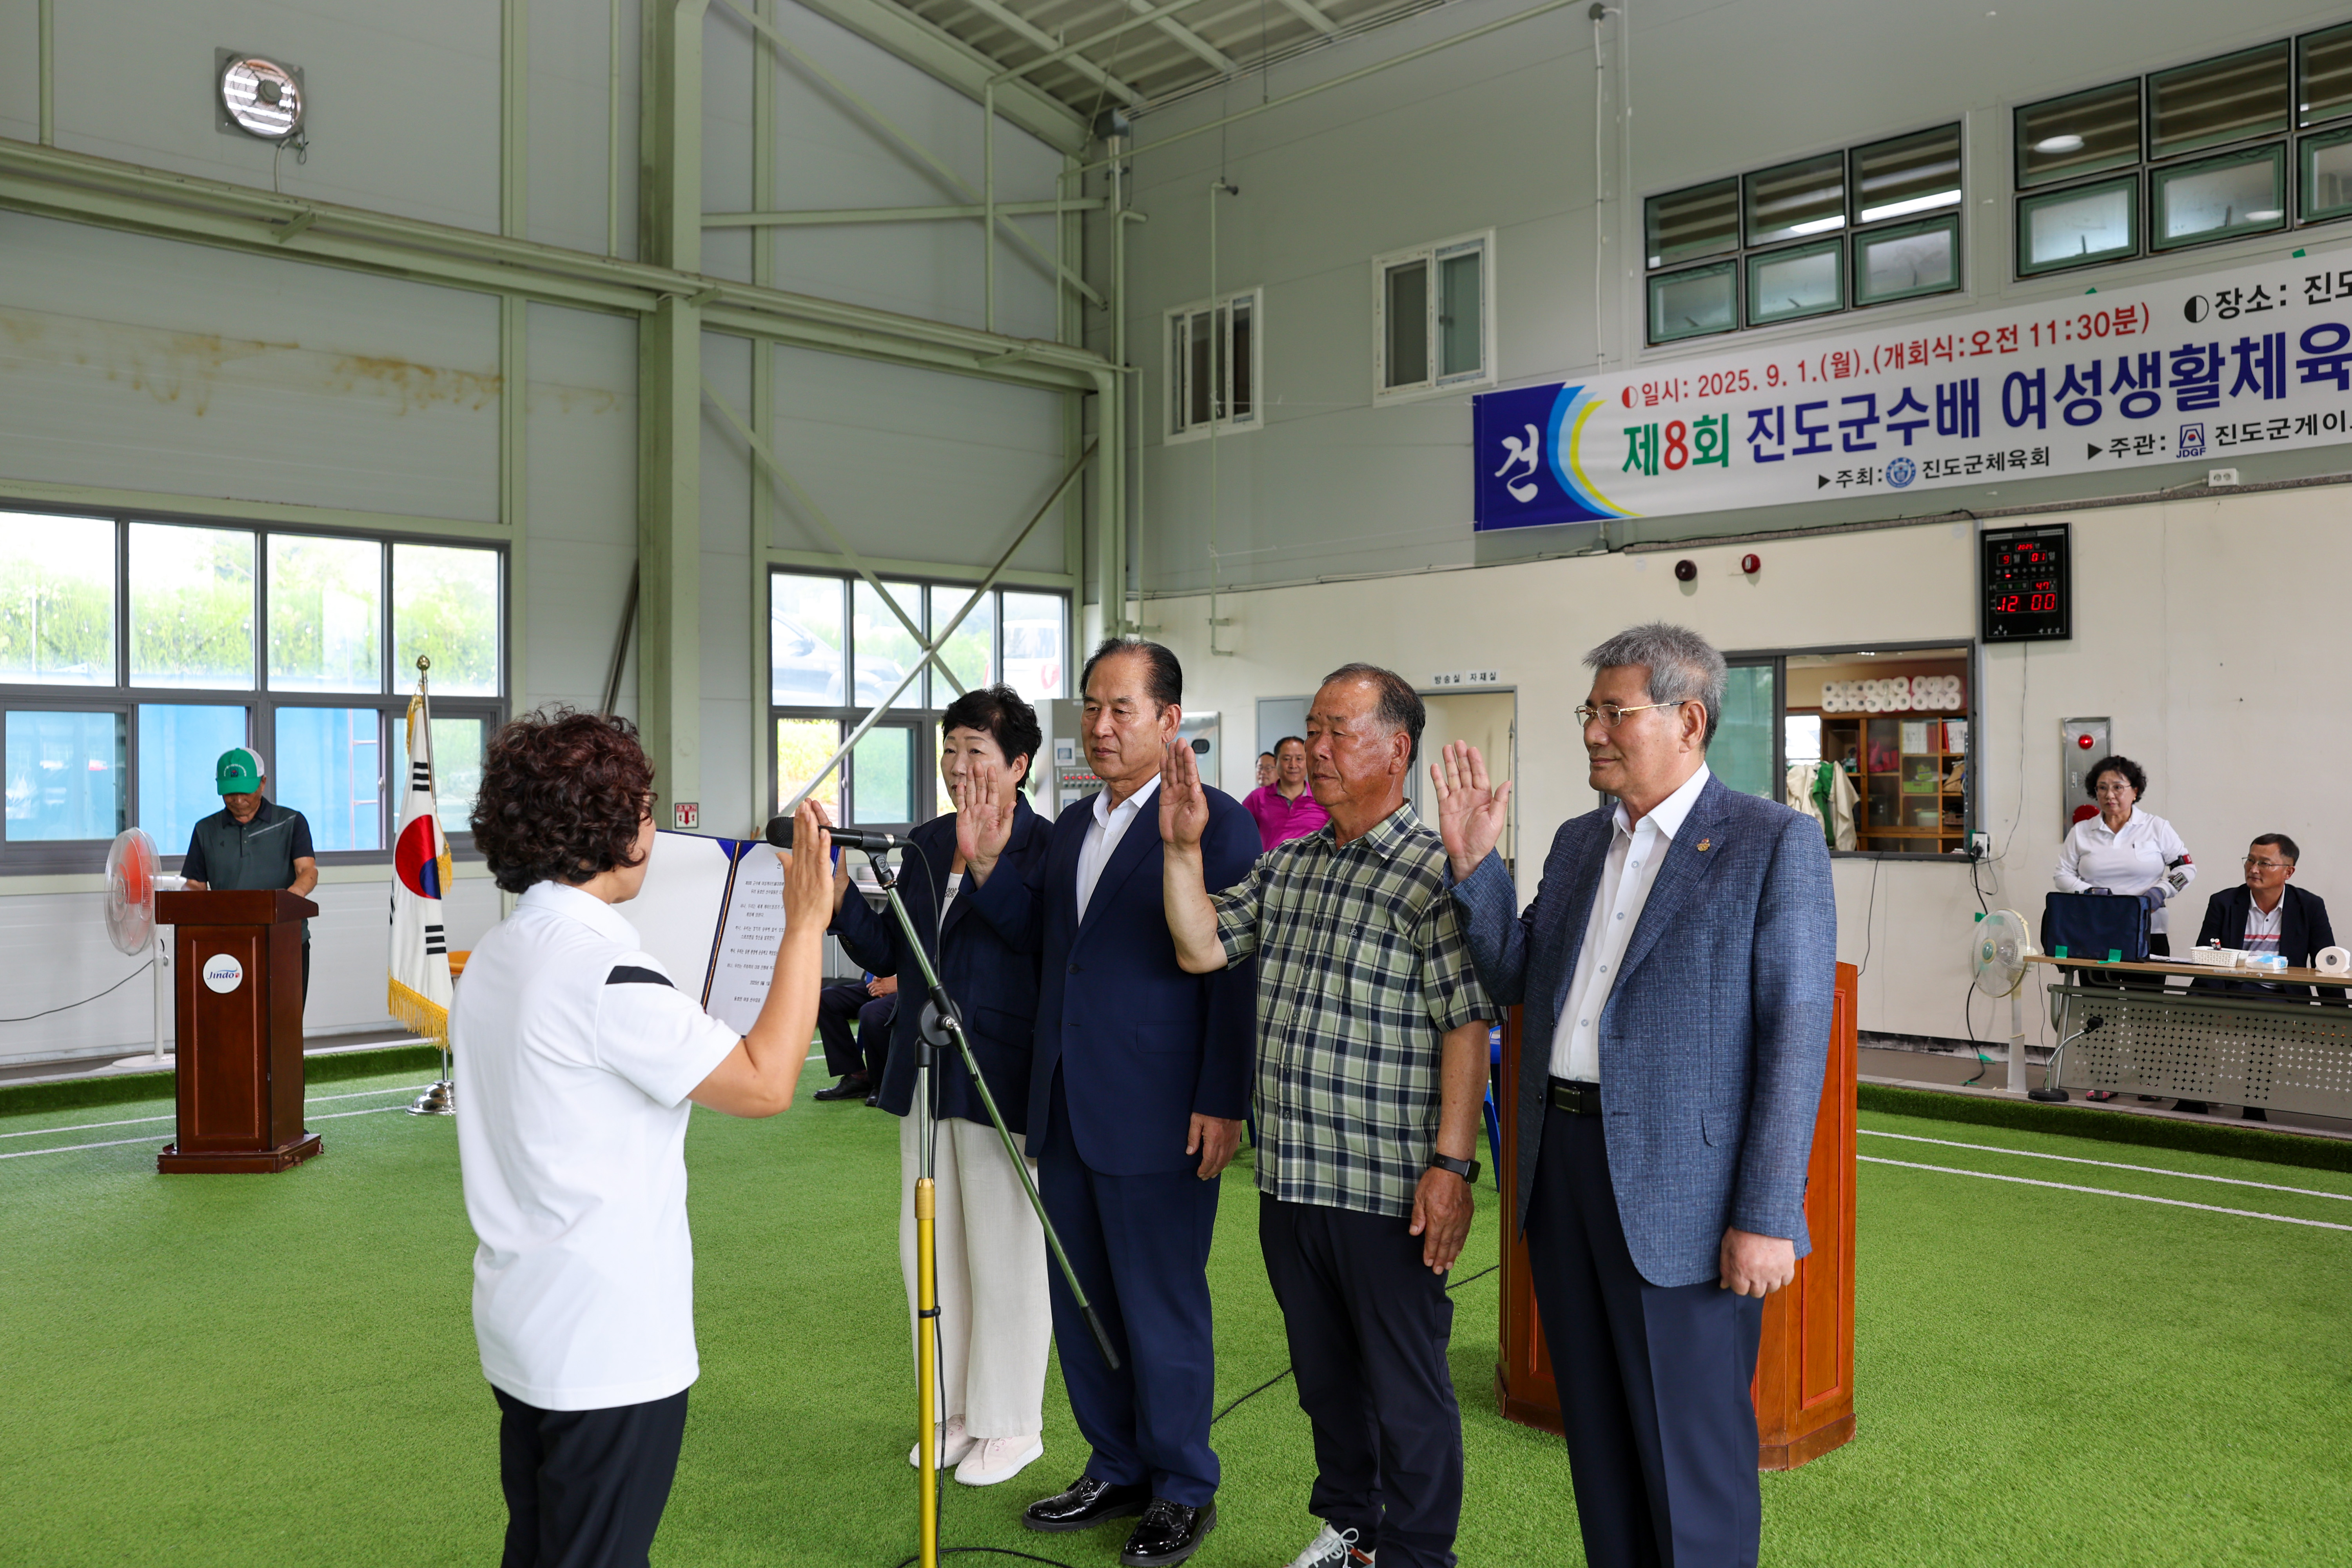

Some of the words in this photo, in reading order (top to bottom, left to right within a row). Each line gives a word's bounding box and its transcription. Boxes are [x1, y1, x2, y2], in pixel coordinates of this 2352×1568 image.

[2215, 284, 2286, 319] 장소:
[1642, 379, 1688, 407] 일시:
[1698, 369, 1758, 397] 2025.
[1767, 364, 1787, 387] 9.
[2030, 303, 2149, 347] 11:30분)
[1622, 413, 1729, 476] 제8회
[1748, 378, 1979, 463] 진도군수배
[2002, 323, 2352, 430] 여성생활체육
[2109, 434, 2165, 458] 주관:
[2215, 410, 2352, 446] 진도군게이
[2176, 447, 2206, 458] JDGF
[1836, 467, 1882, 488] 주최:
[1923, 446, 2049, 479] 진도군체육회
[2003, 555, 2010, 564] 9
[2035, 581, 2049, 590] 47
[1434, 674, 1460, 684] 방송실
[1470, 671, 1496, 681] 자재실
[207, 971, 234, 980] Jindo
